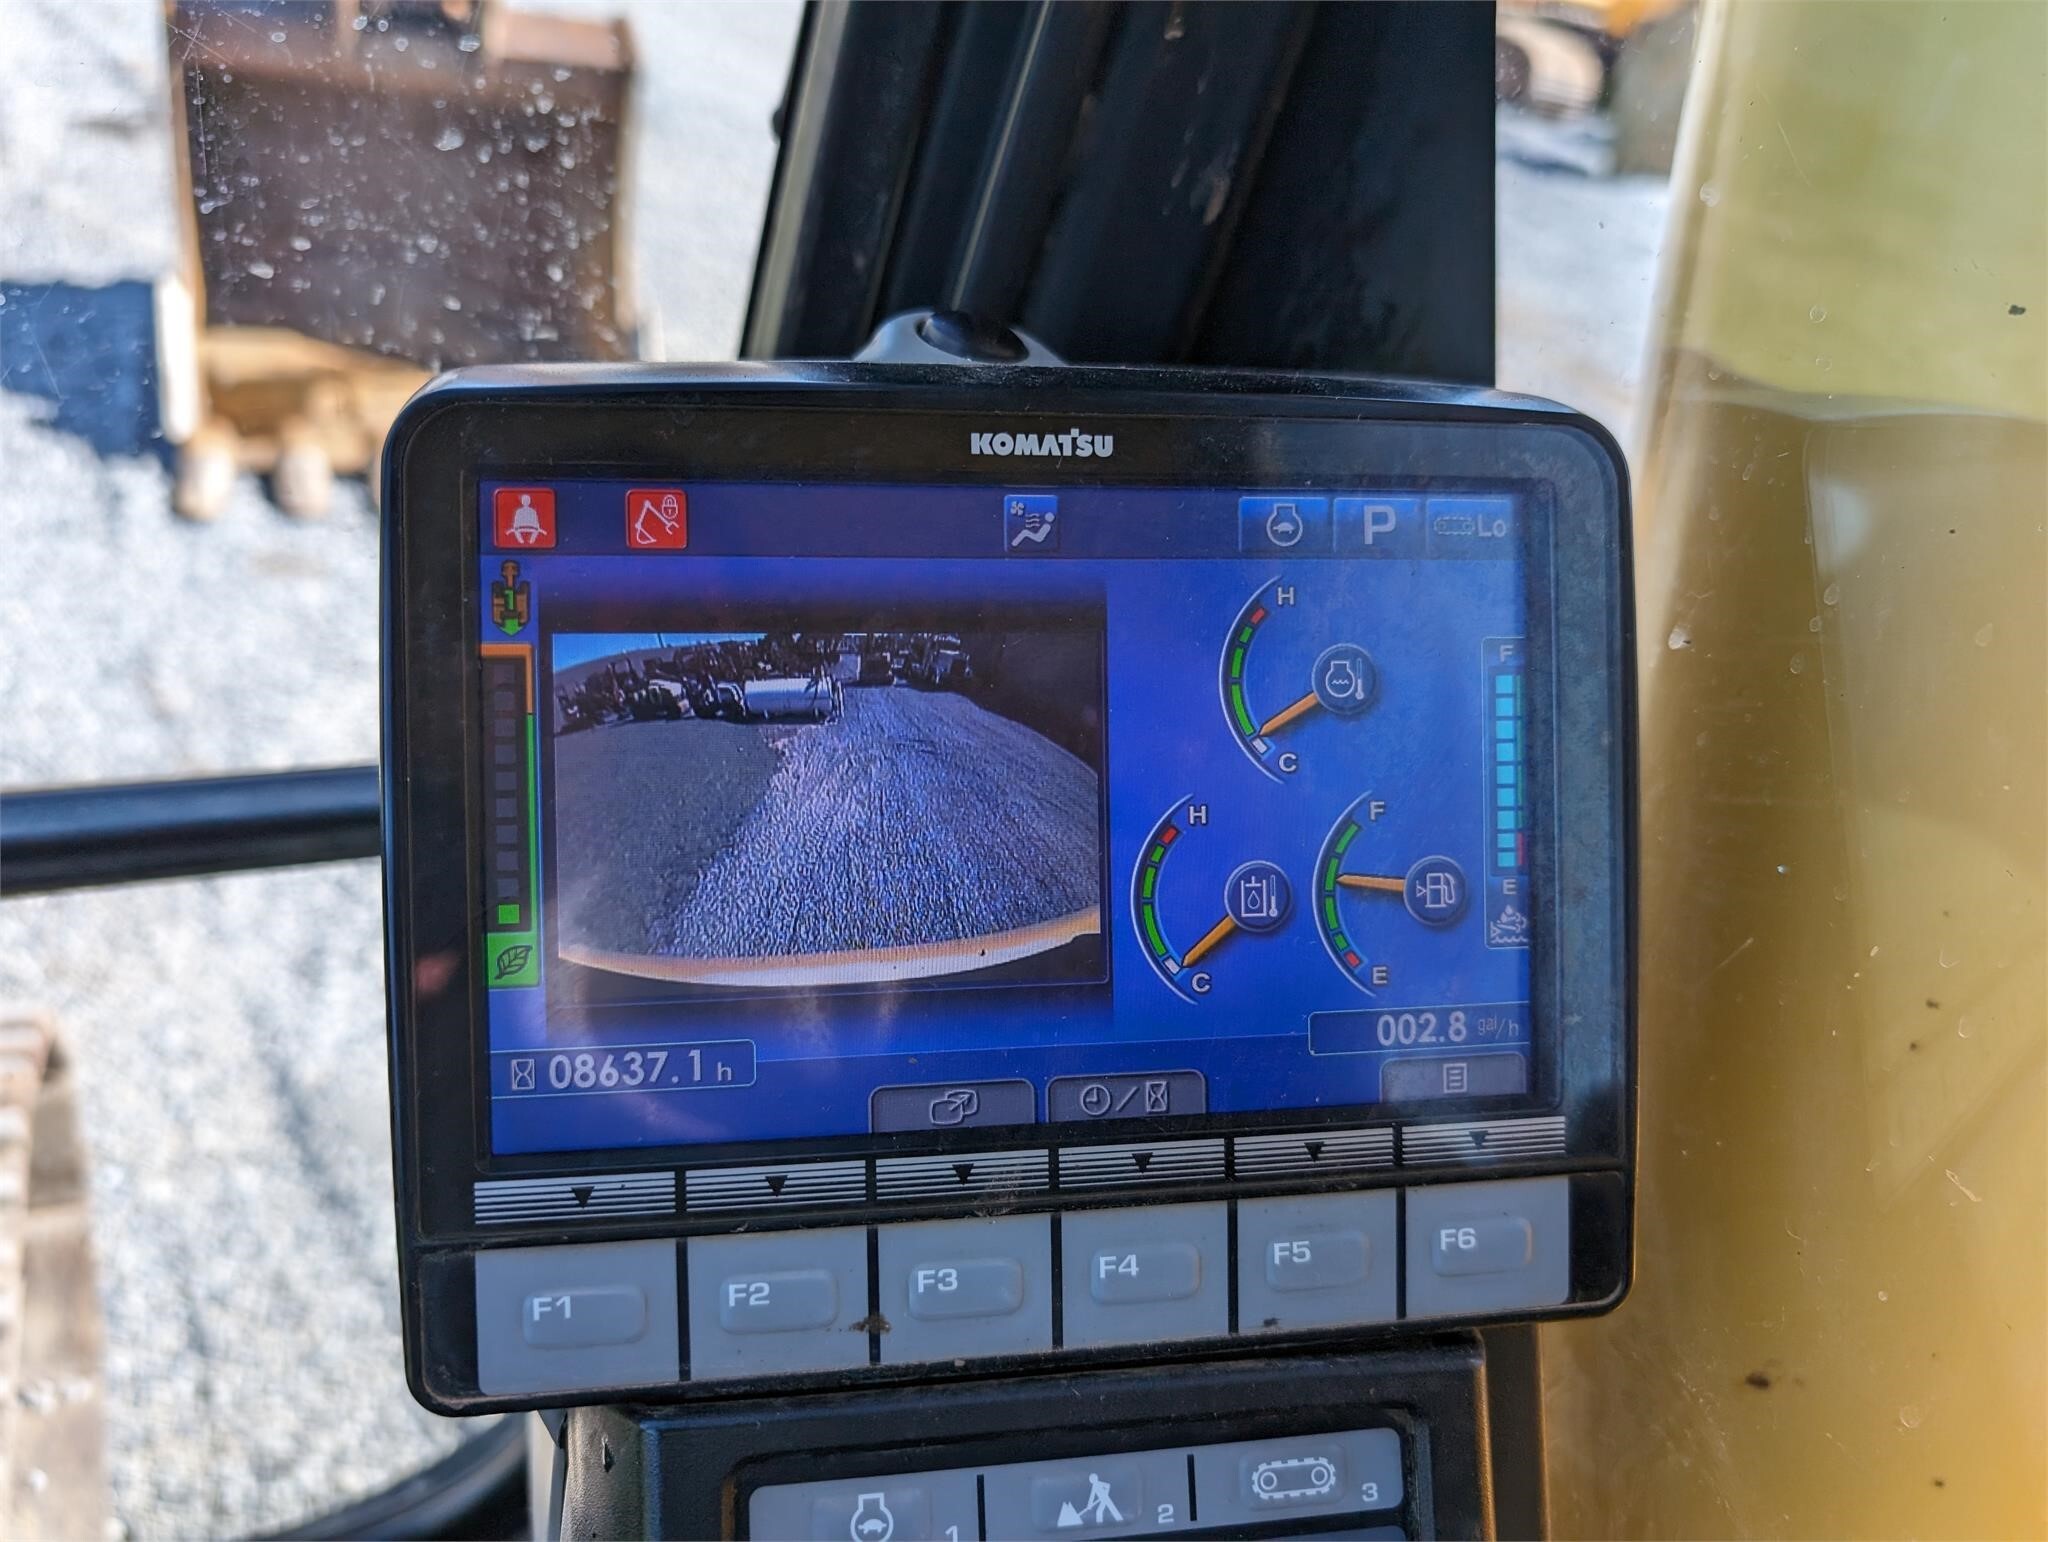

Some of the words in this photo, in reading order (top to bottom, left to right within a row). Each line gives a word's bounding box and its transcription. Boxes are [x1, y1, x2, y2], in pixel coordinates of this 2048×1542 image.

[970, 428, 1114, 458] KOMATSU
[1363, 505, 1397, 545] P
[1478, 514, 1506, 537] Lo
[1277, 587, 1295, 605] H
[1499, 645, 1514, 662] F
[1278, 752, 1297, 773] C
[1188, 806, 1208, 825] H
[1369, 802, 1386, 821] F
[1503, 879, 1517, 895] E
[1191, 972, 1211, 993] C
[1373, 966, 1388, 985] E
[1377, 1011, 1467, 1046] 002.8
[549, 1049, 702, 1089] 08637.1
[716, 1062, 732, 1081] h
[1439, 1227, 1477, 1252] F6
[1273, 1240, 1312, 1265] F5
[1099, 1253, 1139, 1280] F4
[917, 1268, 958, 1293] F3
[728, 1282, 770, 1308] F2
[532, 1295, 571, 1321] F1
[1361, 1482, 1378, 1502] 3
[1157, 1504, 1174, 1524] 2
[945, 1525, 960, 1542] 1
